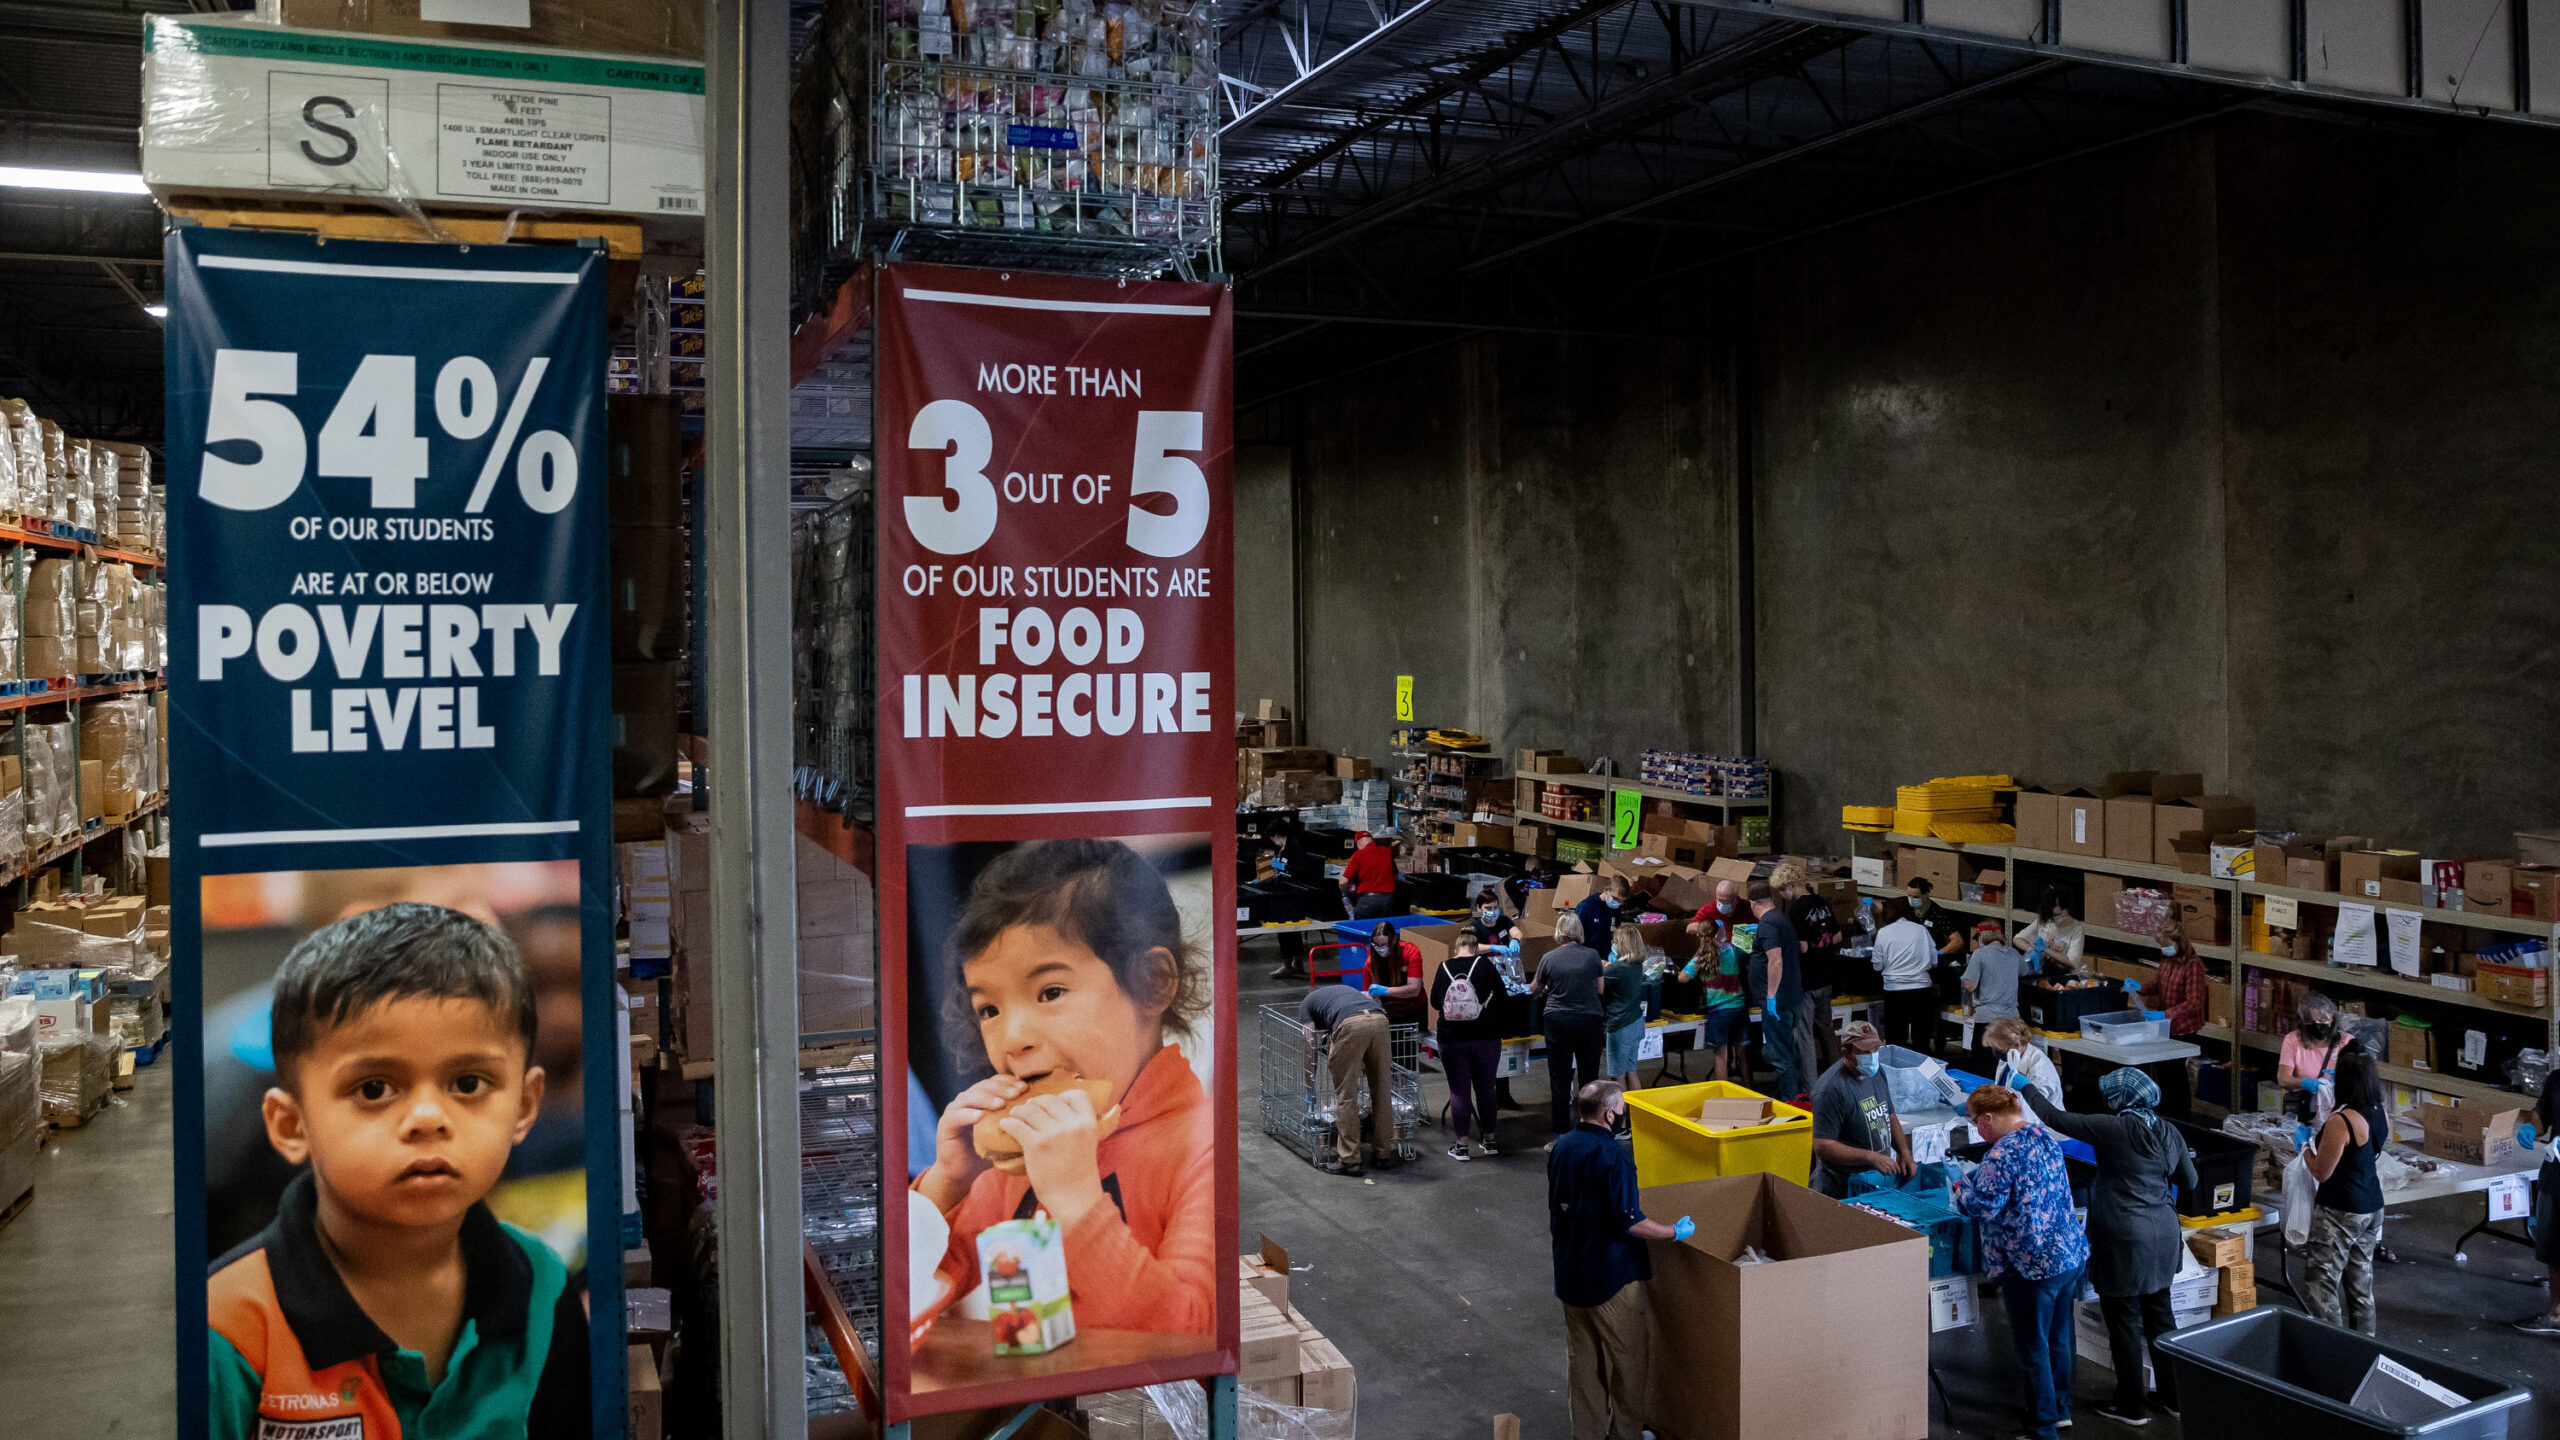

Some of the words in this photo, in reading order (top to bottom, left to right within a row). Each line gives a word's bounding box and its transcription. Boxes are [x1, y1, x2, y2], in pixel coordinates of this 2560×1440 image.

[204, 35, 249, 50] CARTON
[251, 37, 304, 52] CONTAINS
[307, 44, 345, 56] MIDDLE
[348, 47, 391, 59] SECTION
[403, 51, 423, 63] AND
[426, 53, 468, 67] BOTTOM
[470, 56, 513, 71] SECTION
[523, 61, 550, 73] ONLY
[606, 67, 660, 83] CARTON
[663, 73, 670, 83] 2
[673, 73, 689, 85] OF
[693, 76, 700, 86] 2
[492, 94, 536, 105] YULETIDE
[538, 97, 559, 106] PINE
[520, 106, 543, 116] FEET
[301, 95, 358, 167] S
[466, 125, 477, 133] UL
[480, 126, 539, 137] SMARTLIGHT
[541, 131, 572, 140] CLEAR
[574, 133, 606, 142] LIGHTS
[527, 118, 546, 127] TIPS
[475, 137, 510, 147] FLAME
[512, 140, 574, 151] RETARDANT
[483, 150, 519, 159] INDOOR
[521, 152, 539, 161] USE
[542, 153, 567, 162] ONLY
[466, 171, 490, 181] TOLL
[470, 160, 494, 169] YEAR
[497, 162, 533, 172] LIMITED
[536, 165, 587, 175] WARRANTY
[490, 184, 516, 193] MADE
[519, 186, 528, 194] IN
[531, 186, 559, 196] CHINA
[977, 361, 1058, 396] MORE
[1064, 365, 1142, 399] THAN
[198, 348, 579, 514] 54%
[902, 398, 998, 556] 3
[1003, 471, 1064, 504] OUT
[1072, 473, 1111, 505] OF
[1125, 409, 1211, 559] 5
[289, 516, 322, 541] OF
[328, 516, 379, 541] OUR
[383, 517, 495, 542] STUDENTS
[290, 571, 335, 596] ARE
[340, 571, 369, 595] AT
[374, 571, 410, 596] OR
[416, 571, 494, 596] BELOW
[902, 564, 943, 597] OF
[952, 564, 1016, 598] OUR
[1023, 565, 1160, 598] STUDENTS
[1166, 567, 1211, 598] ARE
[197, 602, 579, 682] POVERTY
[979, 606, 1146, 667] FOOD
[902, 670, 1212, 740] INSECURE
[1400, 690, 1410, 717] 3
[290, 686, 496, 753] LEVEL
[1620, 809, 1636, 845] 2
[1865, 1104, 1884, 1122] YOU
[261, 1391, 341, 1411] PETRONAS
[262, 1421, 360, 1440] MOTORSPORT
